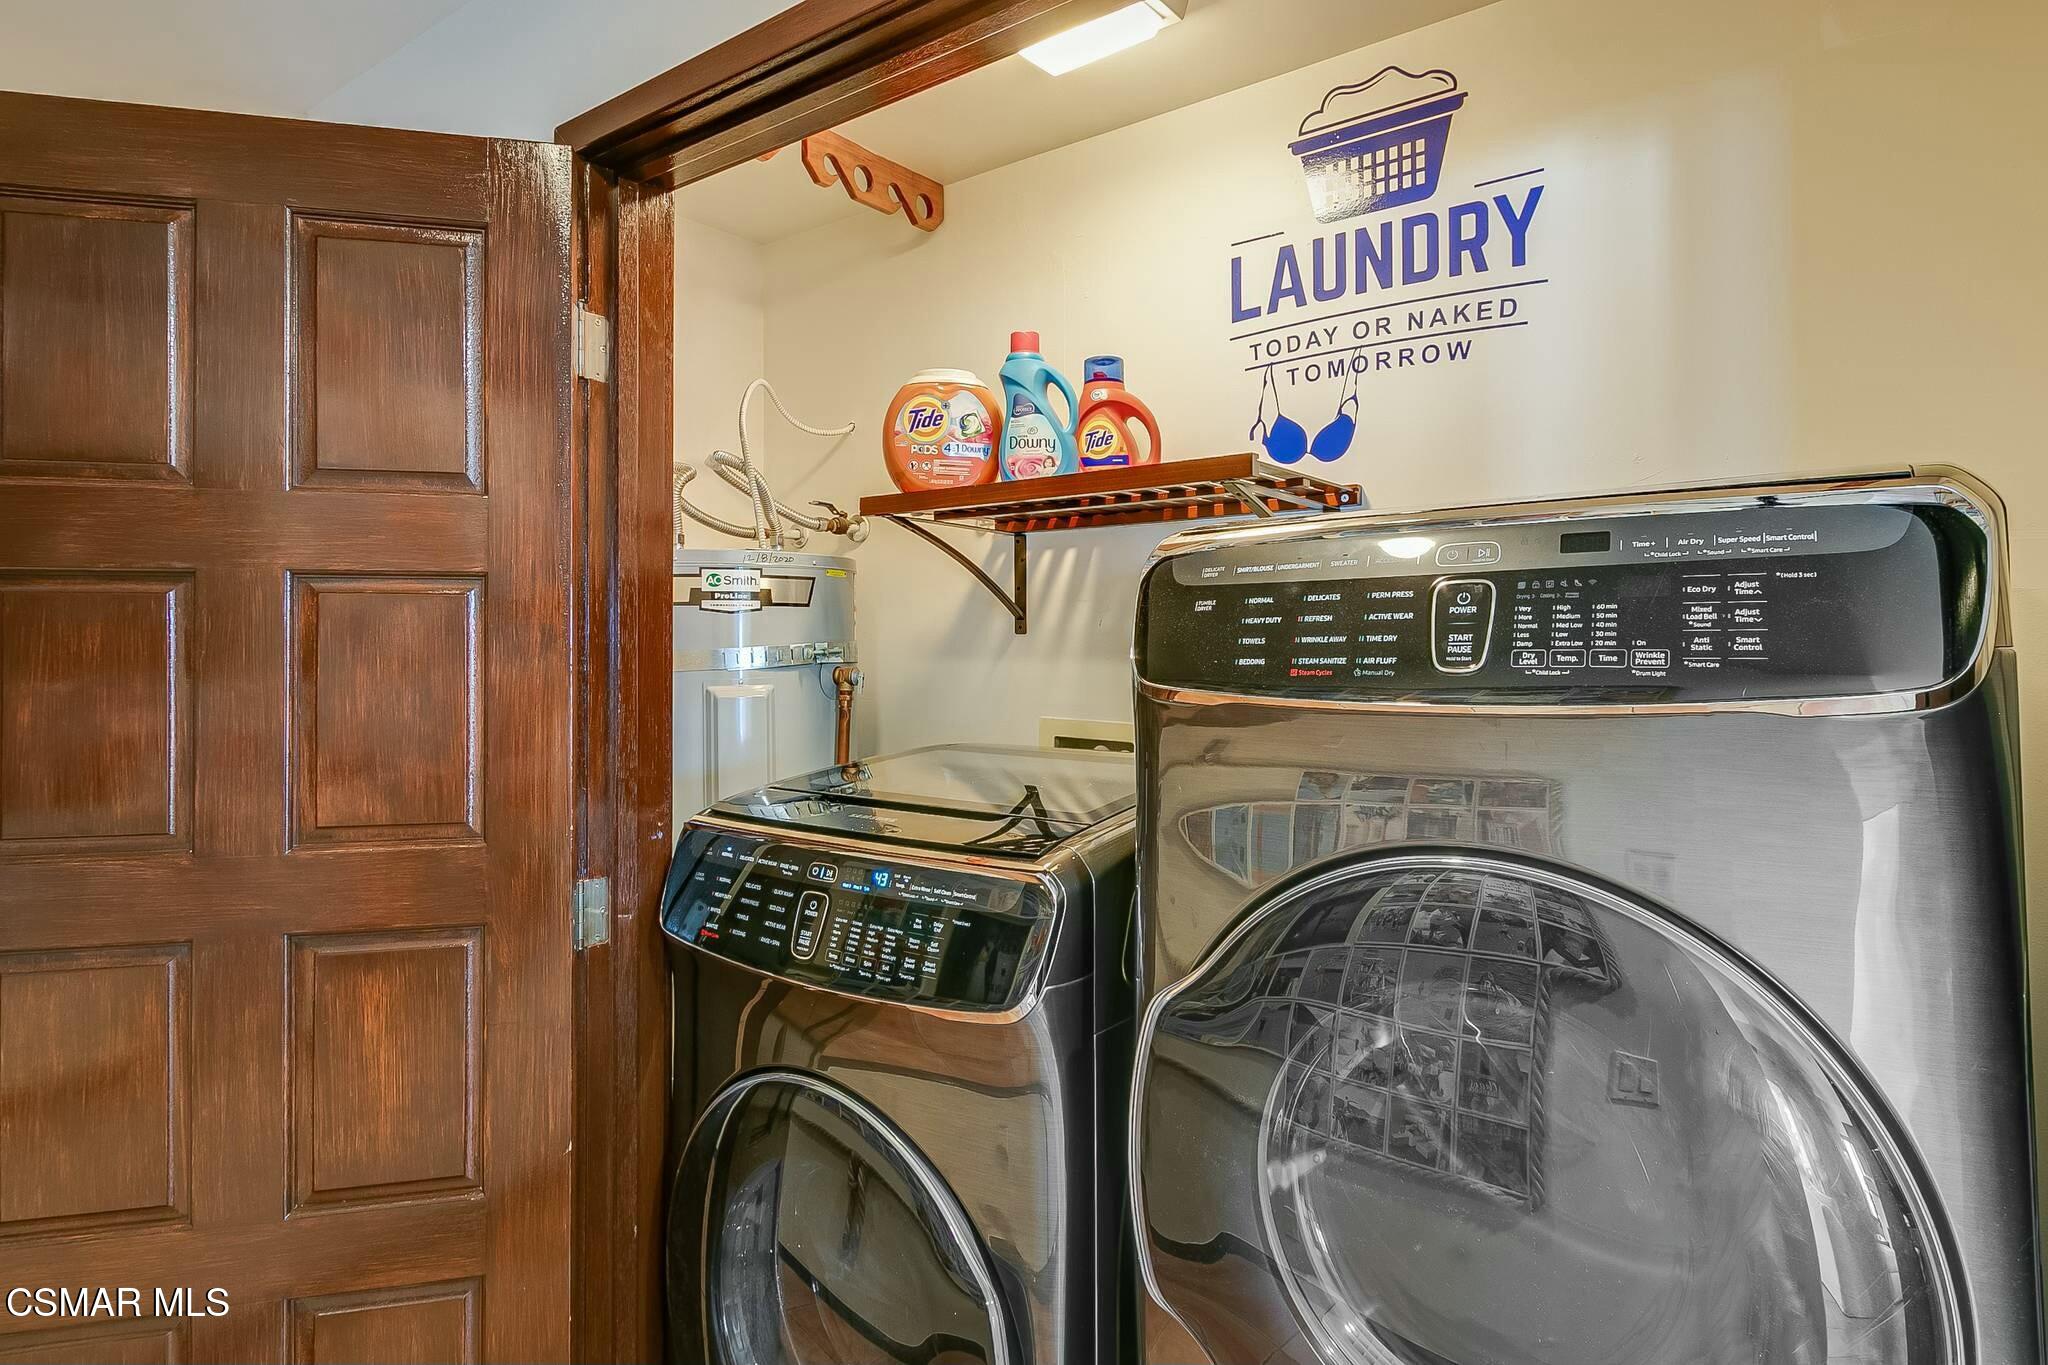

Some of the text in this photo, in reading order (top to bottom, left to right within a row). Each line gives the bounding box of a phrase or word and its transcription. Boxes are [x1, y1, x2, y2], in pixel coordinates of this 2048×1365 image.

[1231, 185, 1545, 324] LAUNDRY
[1249, 298, 1518, 361] TODAY OR NAKED
[1286, 340, 1473, 386] TOMORROW
[908, 408, 945, 433] Tide
[1009, 435, 1056, 453] Downy
[1085, 430, 1114, 453] Tide
[911, 444, 939, 455] PODS
[1690, 538, 1704, 546] Dry
[1717, 535, 1761, 545] Super Speed
[1766, 533, 1815, 542] Smart Control
[743, 551, 795, 564] 12/8/2020
[723, 575, 758, 586] Smith
[1734, 581, 1760, 589] Adjust
[1702, 585, 1717, 594] Dry
[1307, 593, 1341, 602] DELICATES
[1448, 606, 1478, 614] POWER
[1734, 608, 1760, 616] Adjust
[1368, 612, 1414, 621] ACTIVE WEAR
[1328, 635, 1347, 643] AWAY
[1383, 634, 1398, 642] DRY
[1448, 634, 1474, 642] START
[1319, 657, 1348, 665] SANITIZE
[1362, 657, 1398, 665] AIR FLUFF
[1556, 654, 1579, 663] Temp.
[1598, 654, 1618, 662] Time
[1315, 669, 1333, 677] Cycles
[1384, 669, 1395, 677] Dry
[874, 872, 889, 887] 43
